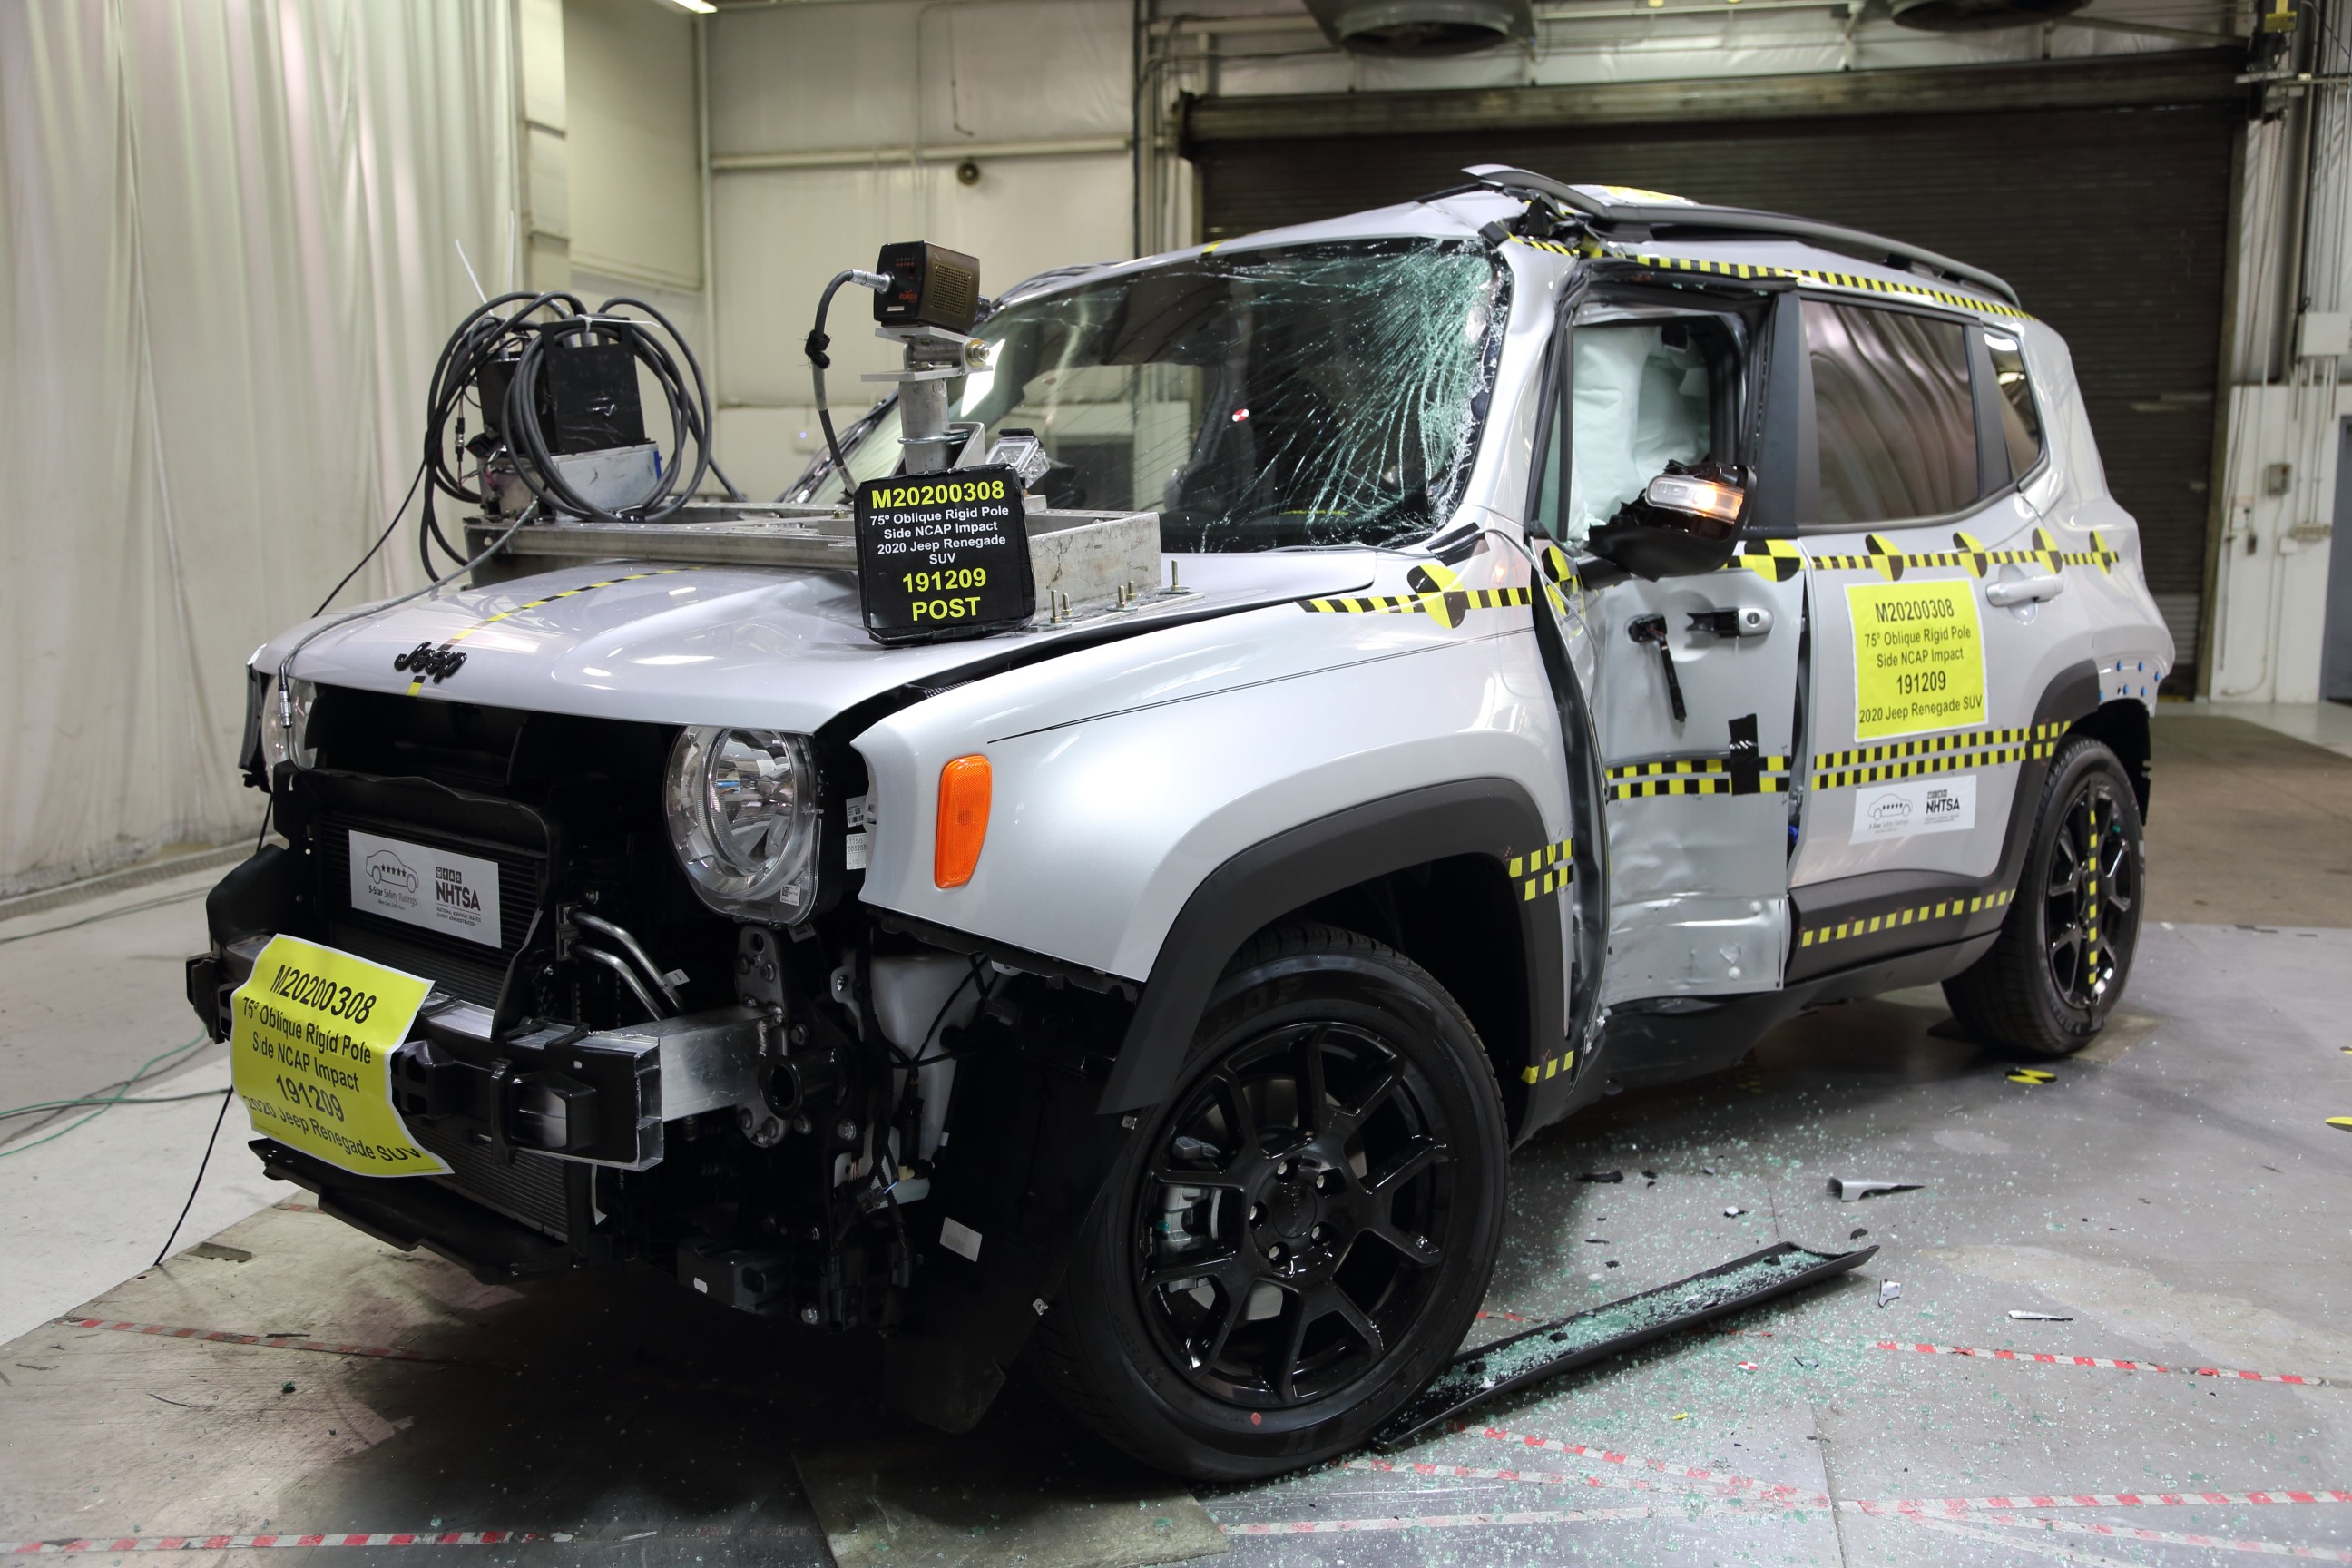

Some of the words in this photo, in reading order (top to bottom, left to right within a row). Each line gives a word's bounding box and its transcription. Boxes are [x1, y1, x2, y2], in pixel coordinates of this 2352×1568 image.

[871, 480, 1005, 509] M20200308
[893, 512, 942, 525] Oblique
[945, 508, 978, 522] Rigid
[982, 505, 1009, 517] Pole
[884, 528, 911, 539] Side
[915, 525, 951, 537] NCAP
[956, 521, 998, 535] Impact
[877, 543, 906, 554] 2020
[910, 541, 940, 553] Jeep
[944, 535, 1006, 549] Renegade
[929, 552, 956, 564] SUV
[902, 568, 987, 593] 191209
[912, 597, 980, 621] POST
[1875, 598, 1955, 623] M20200308
[1884, 632, 1921, 647] Oblique
[1924, 627, 1949, 645] Rigid
[1951, 625, 1971, 639] Pole
[394, 641, 467, 684] Jeep
[1877, 653, 1898, 668] Side
[1901, 650, 1929, 666] NCAP
[1931, 647, 1964, 664] Impact
[1897, 671, 1946, 695] 191209
[1860, 707, 1883, 724] 2020
[1886, 706, 1908, 721] Jeep
[1911, 699, 1960, 717] Renegade
[1963, 695, 1983, 710] SUV
[1926, 798, 1960, 814] NHTSA
[436, 880, 481, 911] NHTSA
[270, 965, 377, 1024] M20200308
[260, 1004, 302, 1040] Oblique
[306, 1022, 338, 1054] Rigid
[342, 1035, 371, 1064] Pole
[252, 1031, 274, 1059] Side
[277, 1041, 310, 1073] NCAP
[314, 1057, 360, 1093] Impact
[276, 1074, 344, 1122] 191209
[243, 1095, 277, 1119] 2020
[280, 1106, 309, 1135] Jeep
[310, 1117, 375, 1160] Renegade
[376, 1145, 422, 1161] SUV
